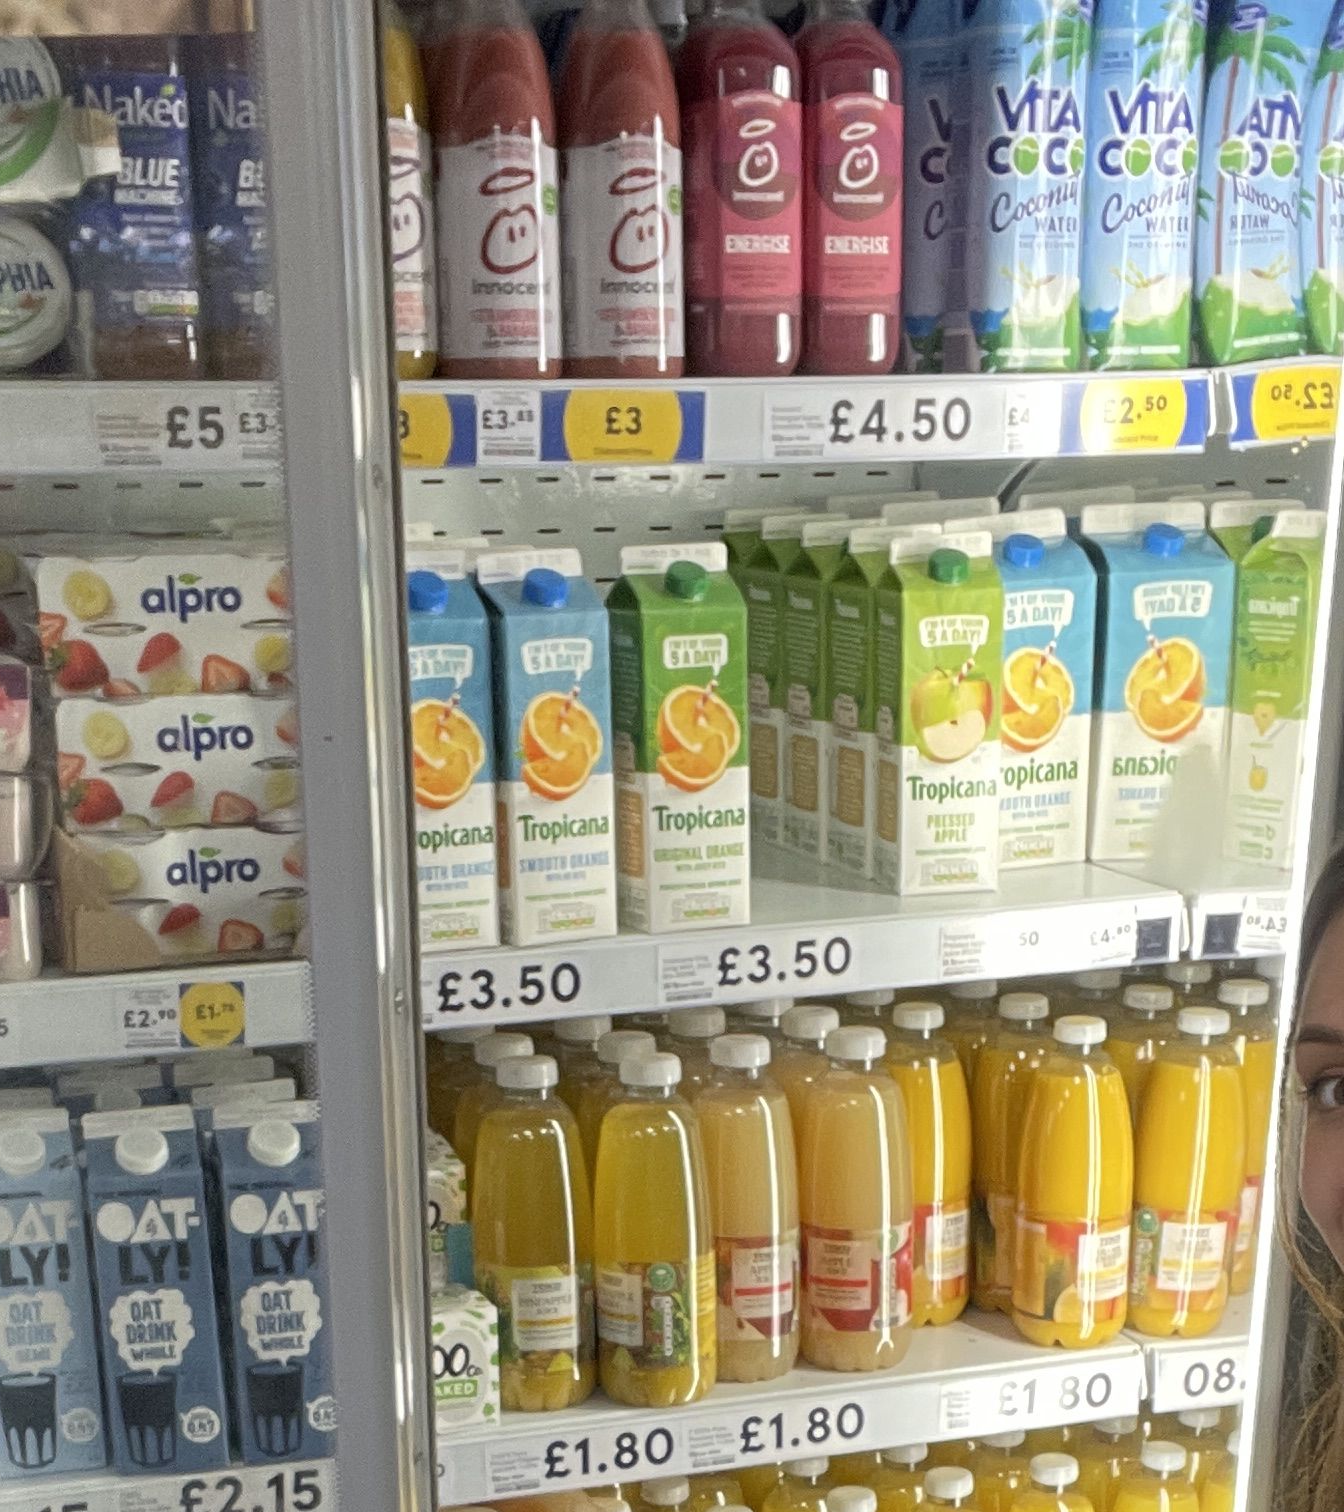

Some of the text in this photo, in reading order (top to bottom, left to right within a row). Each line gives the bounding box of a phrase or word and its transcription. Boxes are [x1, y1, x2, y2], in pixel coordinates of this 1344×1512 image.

[996, 79, 1082, 133] VITA
[1108, 80, 1194, 135] VITA
[118, 157, 181, 187] BLUE
[824, 235, 889, 254] ENERGISE
[166, 405, 225, 450] £5
[605, 406, 643, 435] £3
[828, 397, 973, 445] £4.50
[1104, 394, 1168, 425] £2.50
[140, 578, 243, 622] alpro
[157, 716, 254, 761] alpro
[906, 775, 997, 804] Tropicana
[1000, 757, 1079, 791] opicana
[517, 813, 609, 844] Tropicana
[652, 804, 746, 835] Tropicana
[926, 812, 975, 830] PRESSED
[934, 828, 968, 844] APPLE
[166, 847, 261, 893] alpro
[716, 936, 853, 987] £3.50
[436, 961, 582, 1013] £3.50
[96, 1197, 201, 1244] OAT-
[118, 1241, 191, 1286] LY!
[250, 1231, 318, 1277] LY!
[130, 1300, 164, 1322] OAT
[255, 1311, 306, 1334] DRINK
[260, 1290, 293, 1312] OAT
[125, 1320, 177, 1345] DRINK
[997, 1371, 1113, 1418] £180
[739, 1402, 865, 1455] £1.80
[544, 1427, 675, 1479] £1.80
